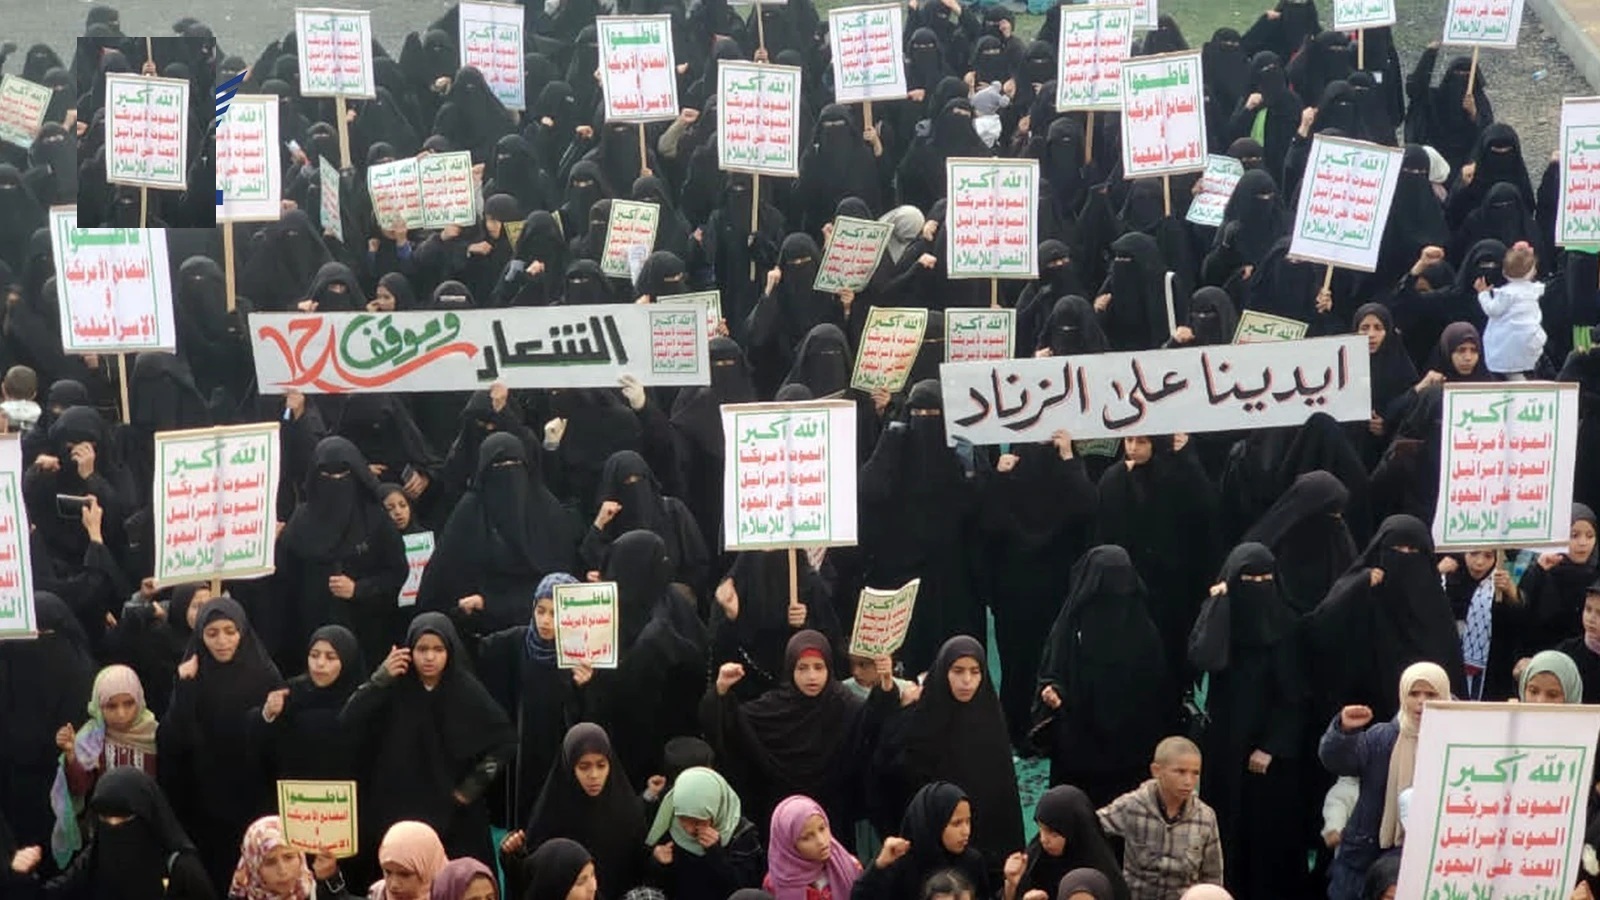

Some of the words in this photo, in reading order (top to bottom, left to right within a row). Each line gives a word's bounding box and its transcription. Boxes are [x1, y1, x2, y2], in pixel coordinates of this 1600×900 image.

[1104, 68, 1120, 79] للعنة
[340, 312, 460, 369] وموقف
[477, 315, 628, 382] الشعار
[1201, 346, 1349, 412] ايدينا
[954, 361, 1090, 432] الزناد
[1455, 395, 1514, 430] أكبر
[1516, 399, 1553, 422] الله
[794, 417, 826, 438] الله
[230, 442, 266, 464] الله
[1509, 433, 1552, 452] الموت
[788, 446, 825, 464] الموت
[788, 470, 825, 486] الموت
[1507, 460, 1550, 478] الموت
[223, 474, 264, 493] الموت
[1516, 484, 1548, 501] اللعنة
[740, 495, 771, 512] اليهود
[798, 492, 826, 506] اللعنة
[1450, 487, 1486, 506] اليهود
[1491, 486, 1510, 505] على
[222, 498, 263, 516] الموت
[231, 519, 262, 535] اللعنة
[790, 512, 827, 537] النصر
[1504, 507, 1546, 535] النصر
[166, 528, 201, 547] اليهود
[220, 540, 262, 567] النصر
[1450, 748, 1528, 792] أكبر
[1528, 754, 1576, 783] الله
[1515, 796, 1571, 818] الموت
[1511, 828, 1566, 850] الموت
[1435, 856, 1482, 878] اليهود
[1487, 856, 1513, 879] على
[1520, 856, 1562, 877] اللعنة
